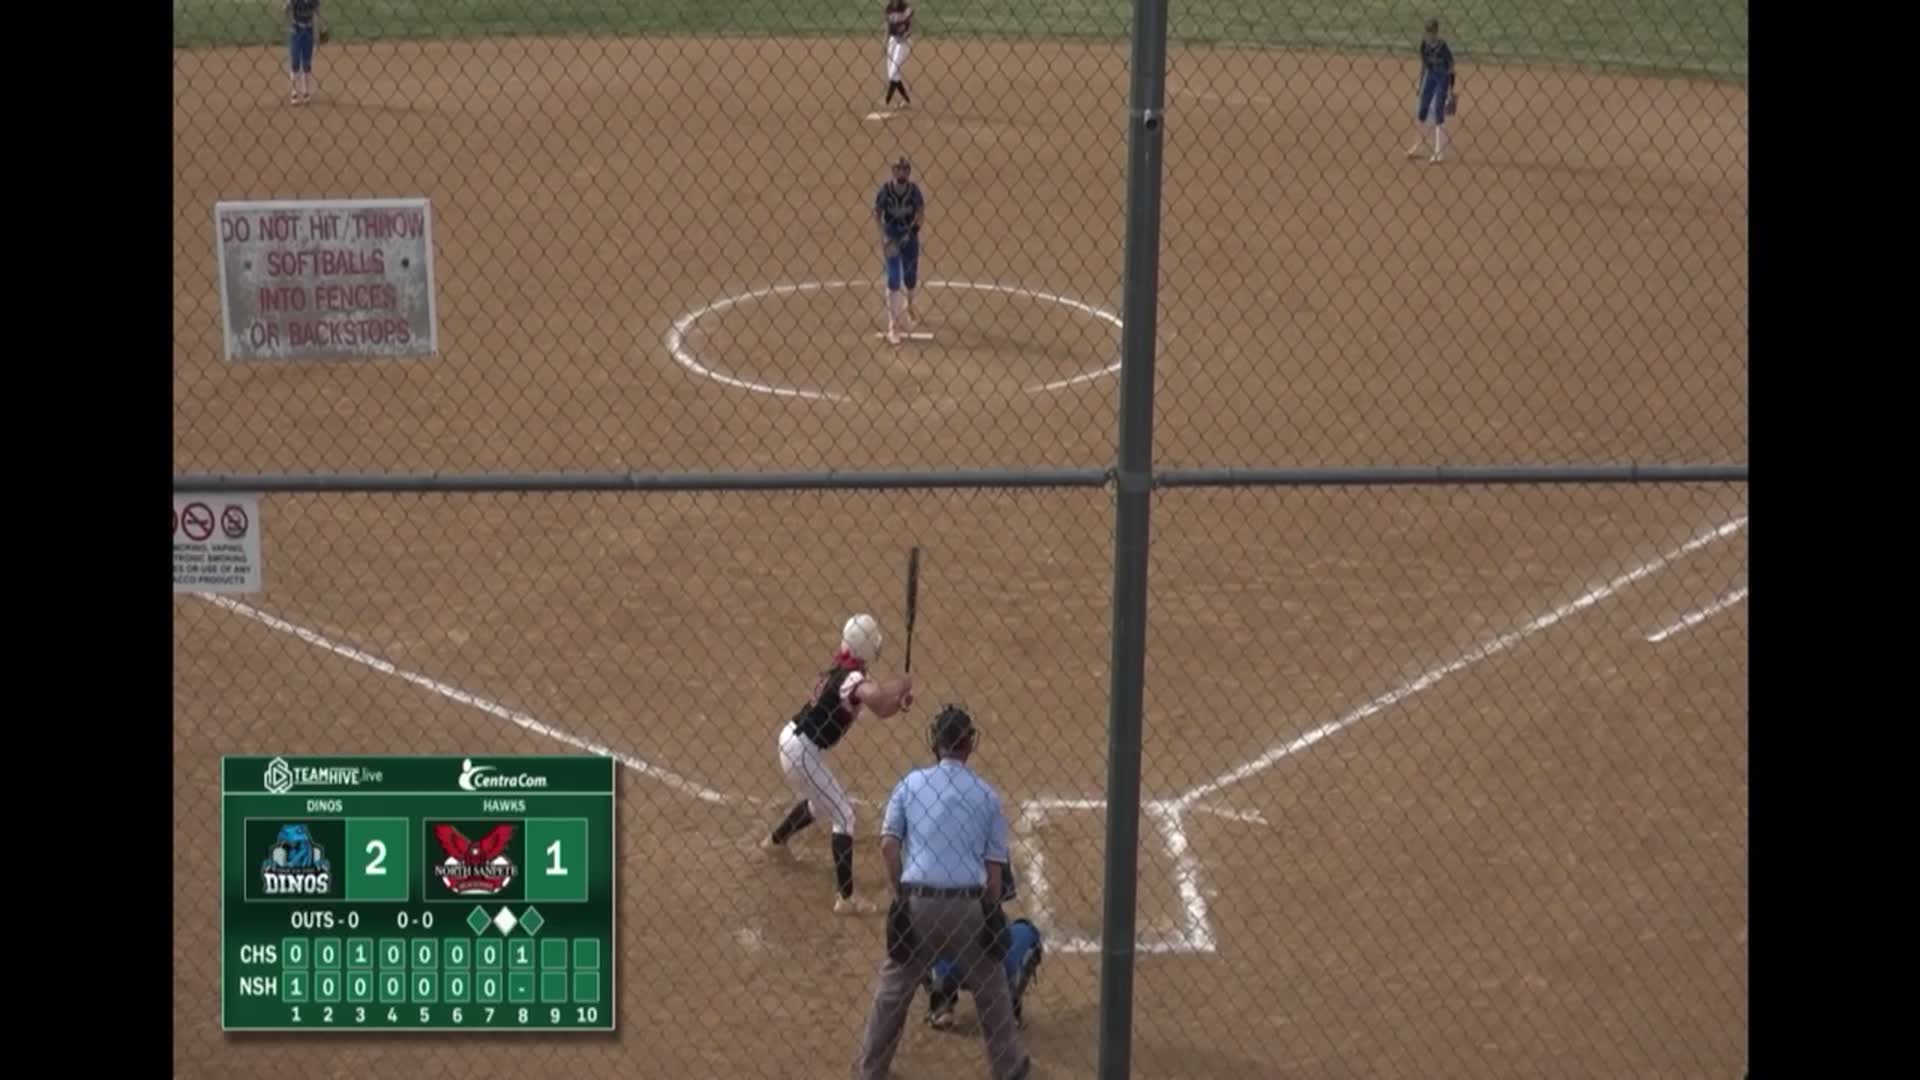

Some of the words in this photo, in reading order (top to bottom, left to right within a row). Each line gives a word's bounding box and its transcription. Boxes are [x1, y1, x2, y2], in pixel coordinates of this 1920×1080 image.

[221, 216, 249, 242] DO
[259, 215, 299, 241] NOT
[267, 249, 385, 276] SOFTBALLS
[259, 285, 306, 313] INTO
[315, 283, 397, 311] FENCES
[251, 321, 280, 348] OR
[288, 317, 411, 346] BACKSTOPS
[186, 565, 198, 573] OR
[201, 565, 217, 573] USE
[220, 565, 232, 573] OF
[234, 565, 251, 573] ANY
[207, 554, 247, 562] SMOKING
[198, 575, 246, 584] PRODUCTS
